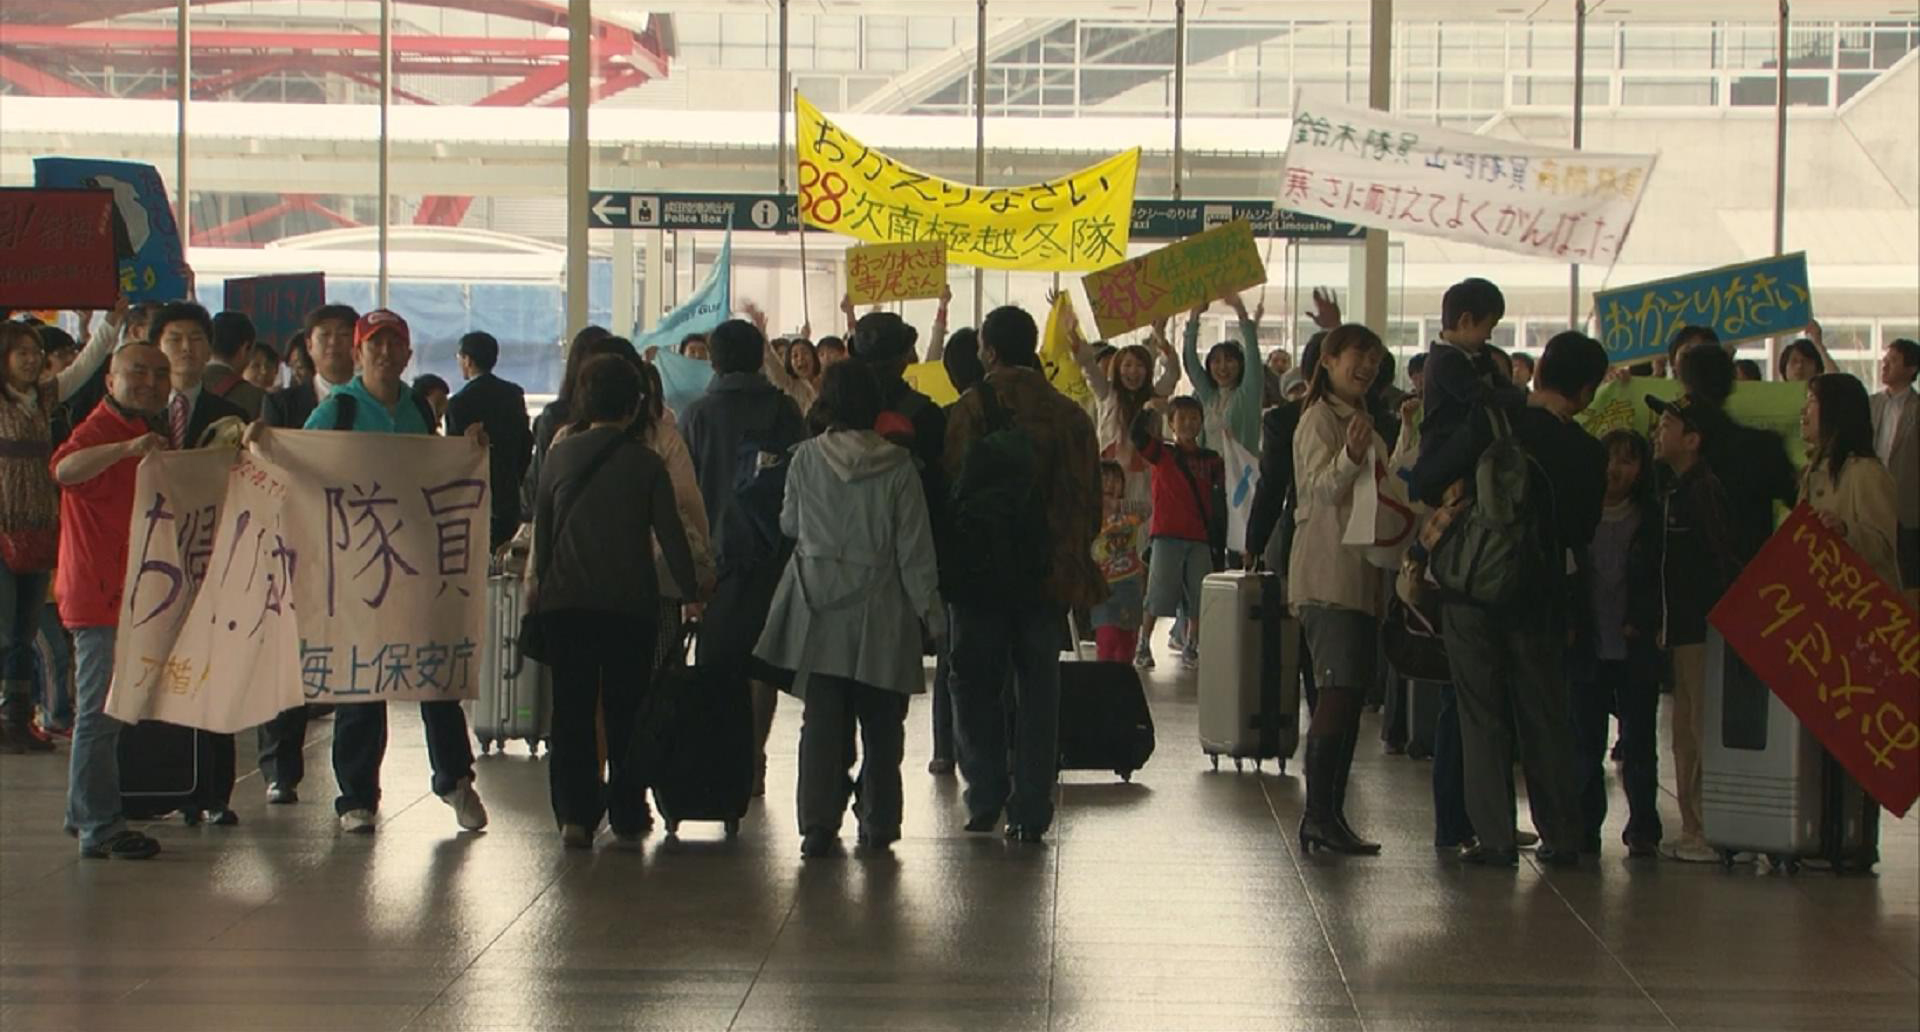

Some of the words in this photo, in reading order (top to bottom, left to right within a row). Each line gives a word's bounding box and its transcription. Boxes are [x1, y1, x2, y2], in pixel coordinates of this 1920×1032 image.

[812, 119, 1110, 214] おかえりなさい
[664, 213, 698, 224] Police
[700, 213, 723, 224] Box
[1275, 220, 1333, 233] Limousine
[1604, 272, 1808, 351] おかえりなさい
[323, 478, 486, 617] 隊員
